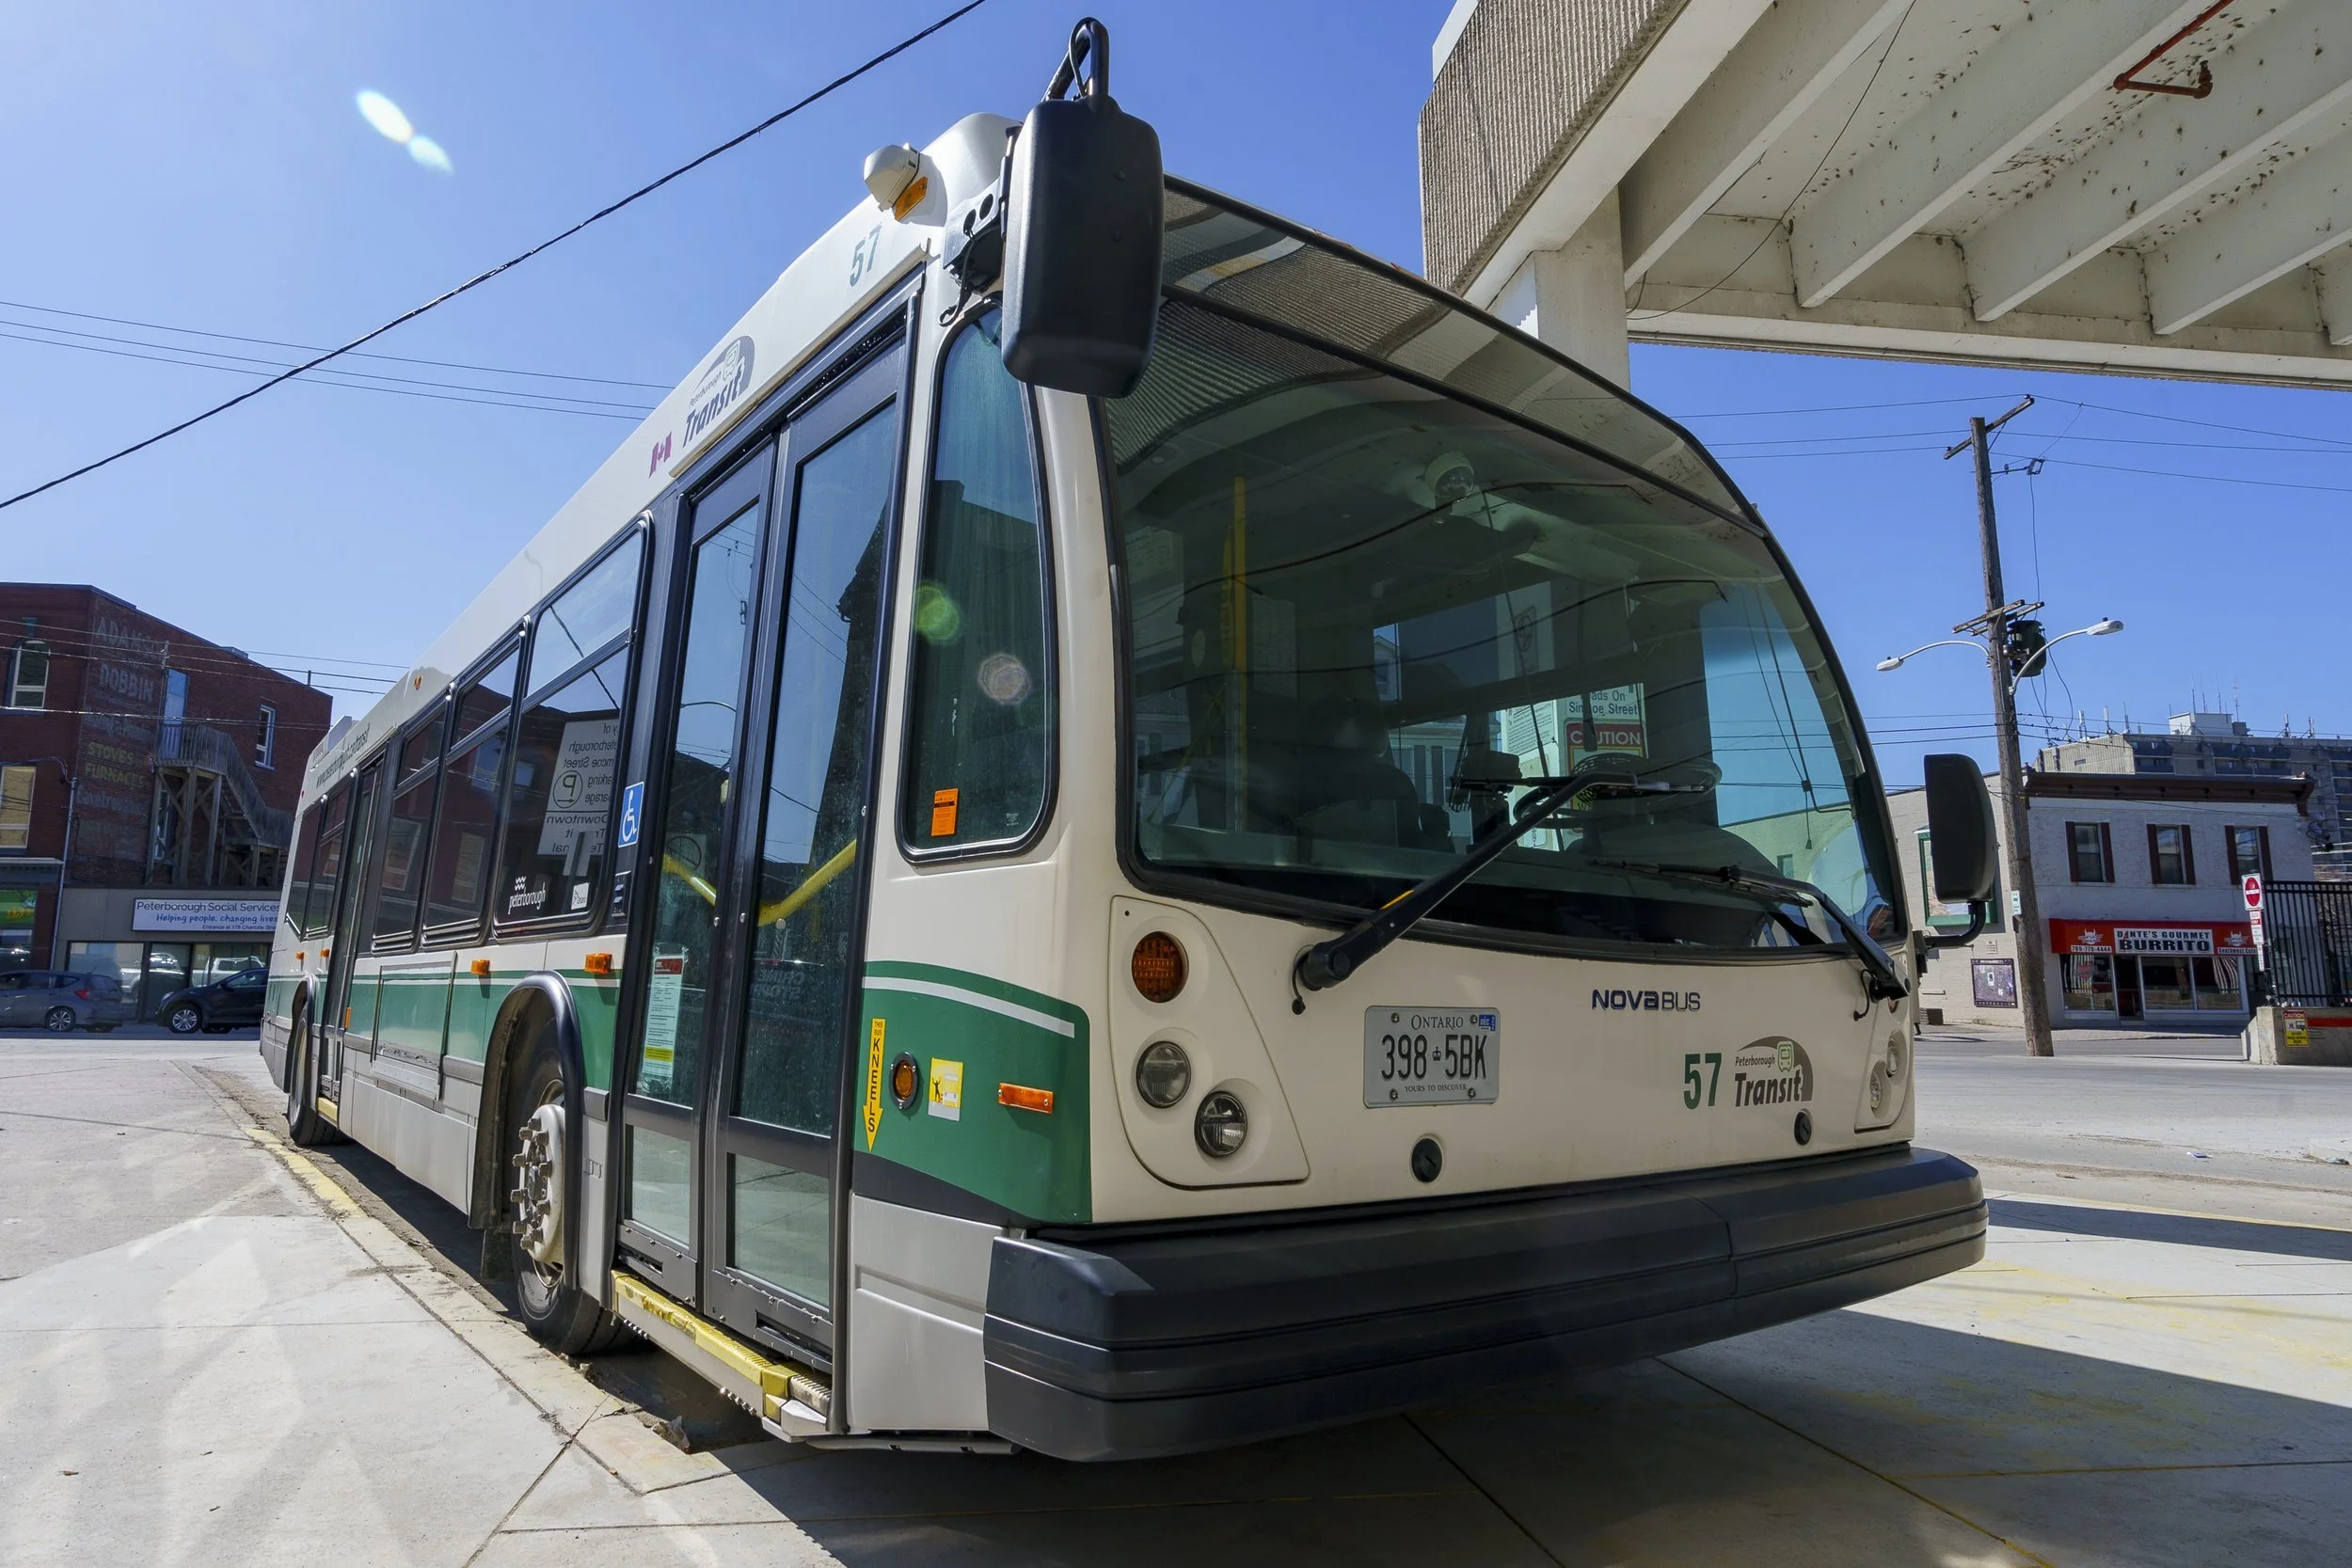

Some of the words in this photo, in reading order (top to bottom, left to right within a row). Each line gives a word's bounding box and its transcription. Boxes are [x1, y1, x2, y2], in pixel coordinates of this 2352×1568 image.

[850, 222, 882, 287] 57
[683, 363, 743, 448] Transit
[100, 661, 154, 704] DOBBIN
[1591, 690, 1608, 701] ads
[1613, 689, 1626, 701] On
[1569, 702, 1604, 714] Sioe
[1608, 703, 1638, 715] Street
[1570, 731, 1641, 745] CUTION
[508, 882, 546, 914] peterborough
[137, 901, 206, 912] Peterborough
[208, 902, 237, 911] Social
[156, 913, 186, 924] Helping
[189, 914, 217, 925] people,
[220, 914, 257, 925] changing
[2117, 930, 2158, 940] DANTE'S
[2161, 931, 2210, 940] GOURMET
[2119, 940, 2210, 952] BURRITO
[1411, 1015, 1464, 1030] ONTARIO
[1381, 1035, 1428, 1080] 398
[1445, 1034, 1487, 1080] 5BK
[1735, 1053, 1776, 1068] Peterborough
[867, 1037, 882, 1132] KNEELS
[1438, 1084, 1468, 1092] DISCOVER
[1683, 1052, 1722, 1110] 57
[1734, 1069, 1802, 1107] Transit
